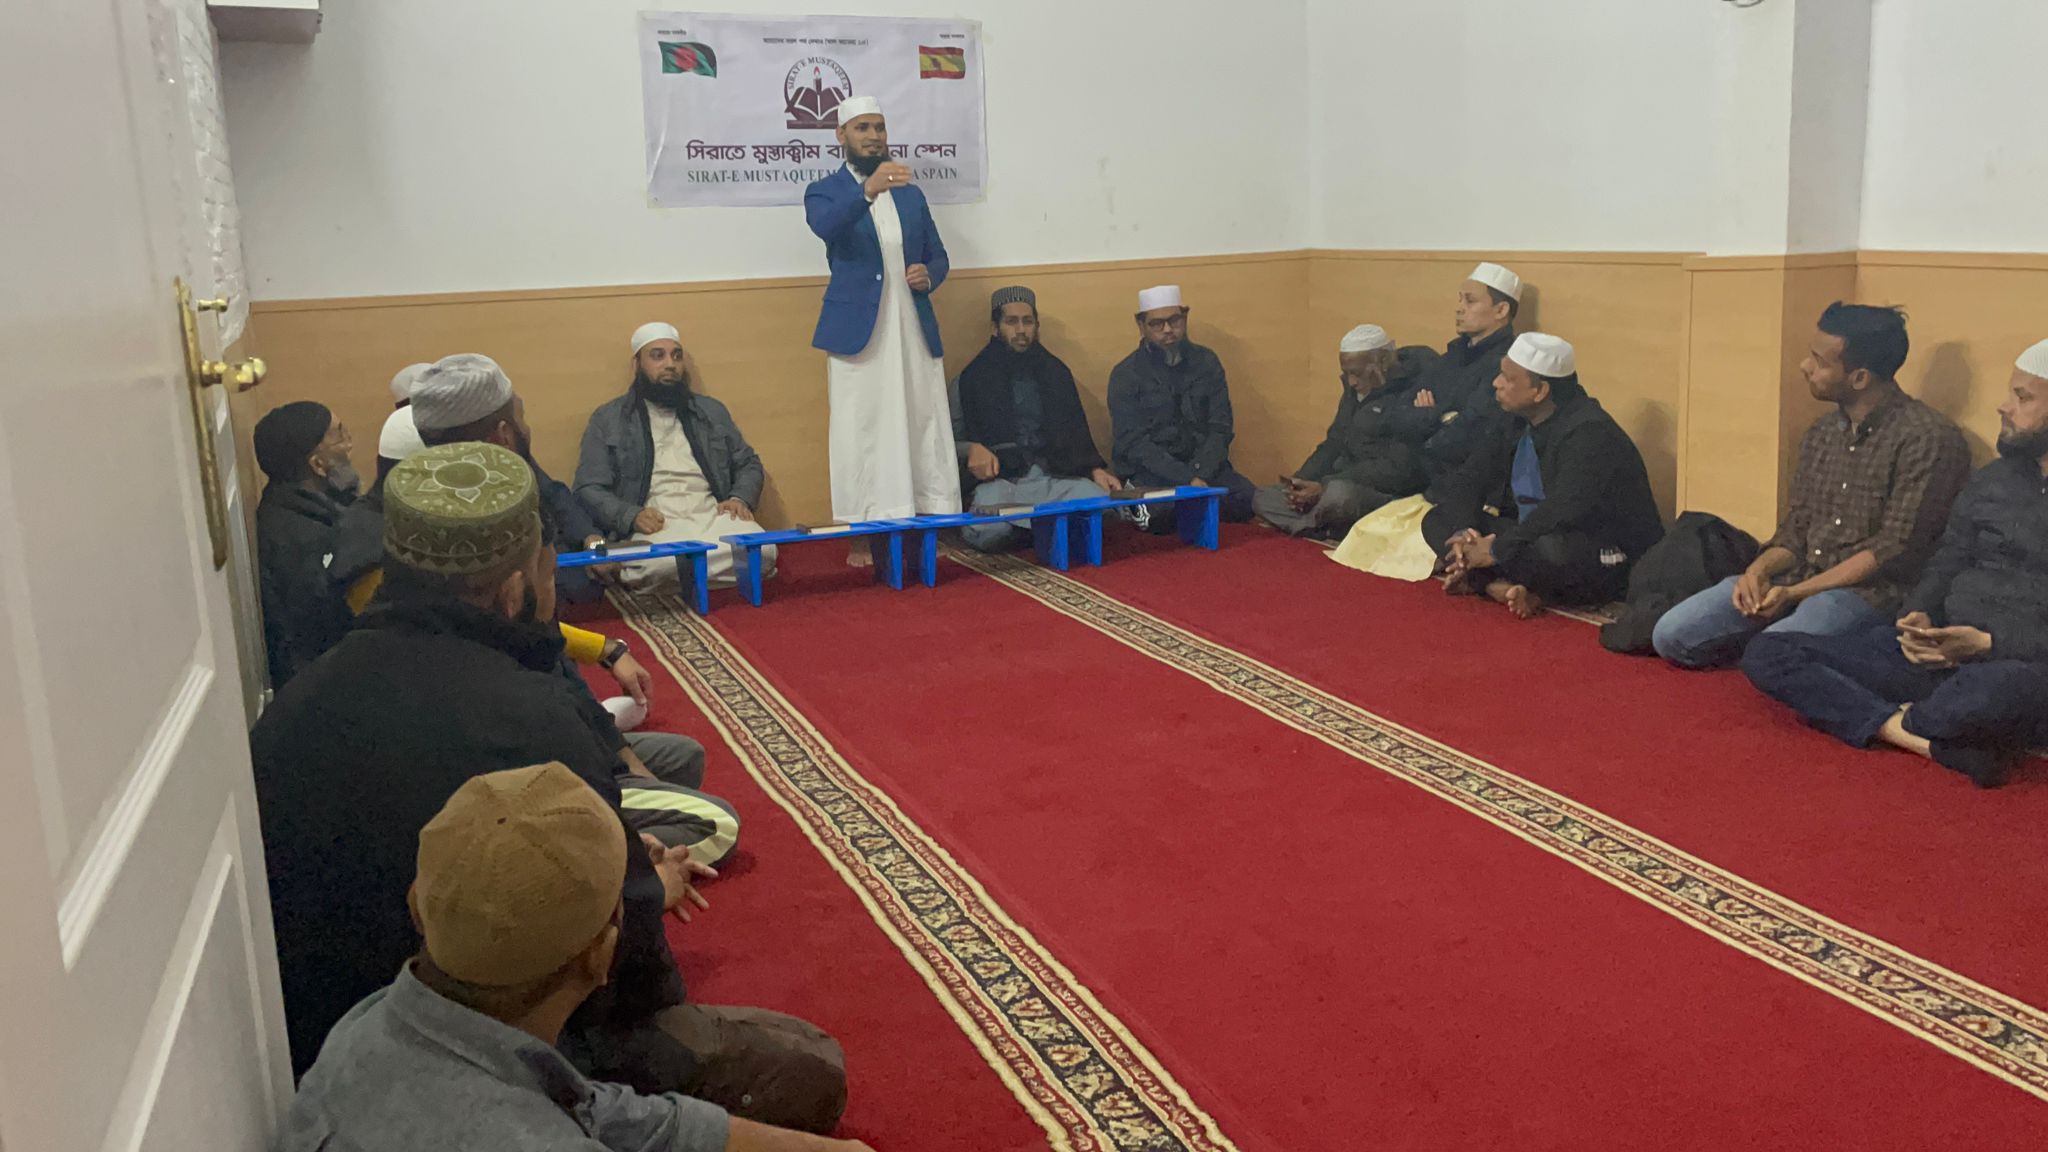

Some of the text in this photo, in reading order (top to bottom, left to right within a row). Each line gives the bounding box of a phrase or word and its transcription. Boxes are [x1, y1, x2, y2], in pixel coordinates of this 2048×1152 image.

[686, 139, 746, 160] সিরাতে
[914, 144, 957, 158] স্পেন
[687, 169, 740, 183] SIRAT-E
[922, 167, 958, 180] SPAIN
